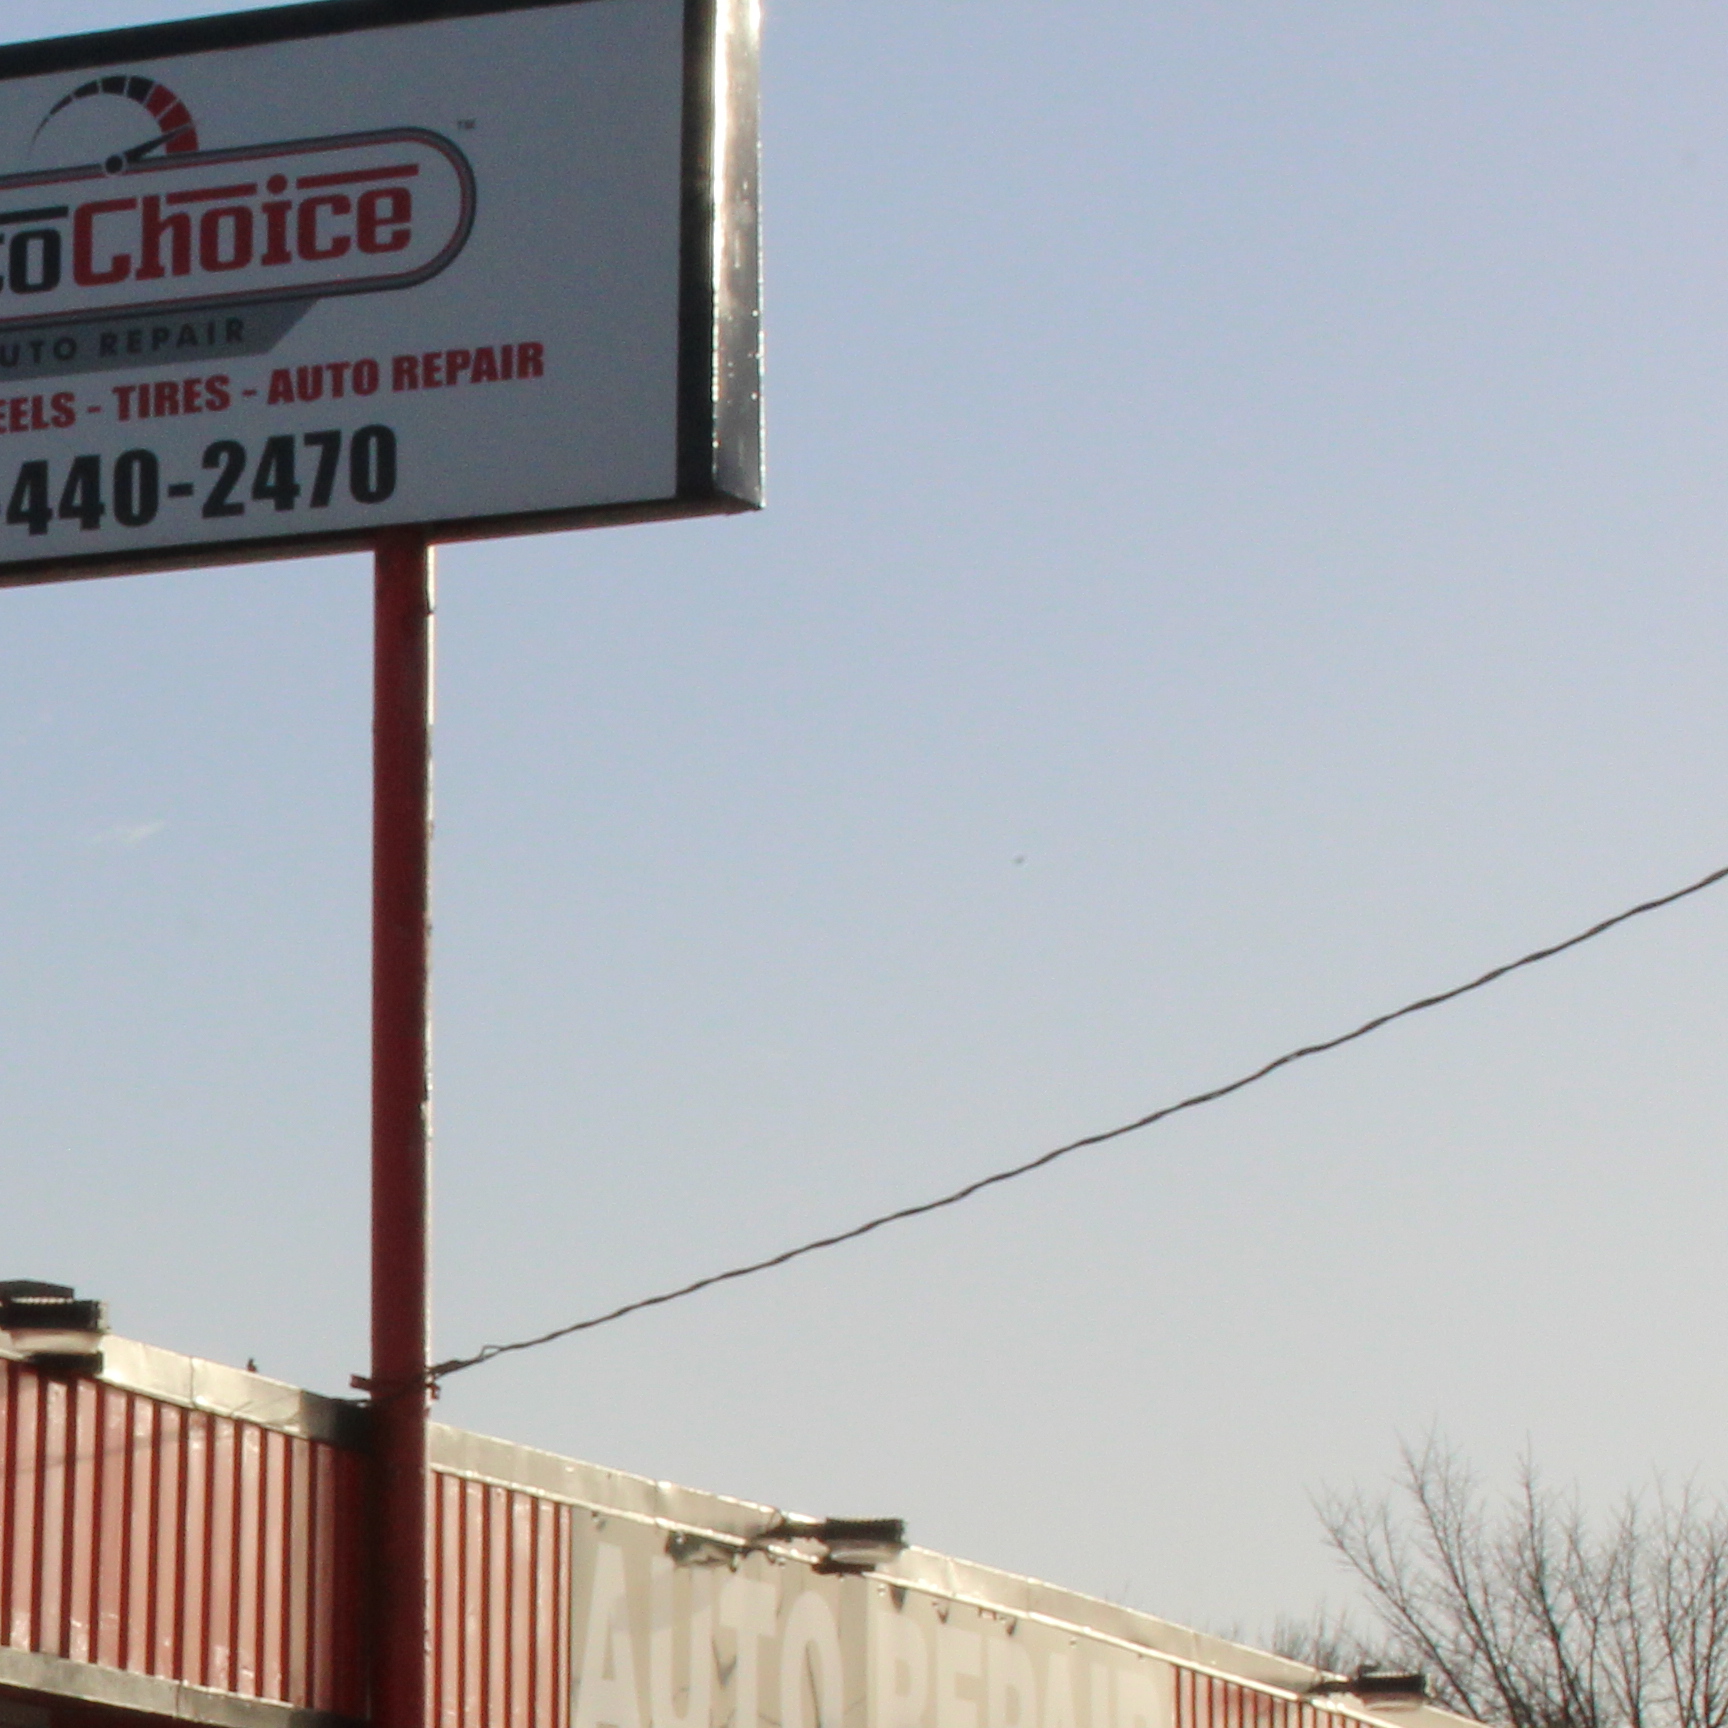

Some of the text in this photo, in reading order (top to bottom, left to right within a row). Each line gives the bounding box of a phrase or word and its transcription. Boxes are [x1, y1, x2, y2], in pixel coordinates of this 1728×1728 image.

[99, 316, 245, 358] REPAIR
[113, 375, 231, 421] TIRES
[267, 358, 380, 405] AUTO
[392, 341, 544, 392] REPAIR
